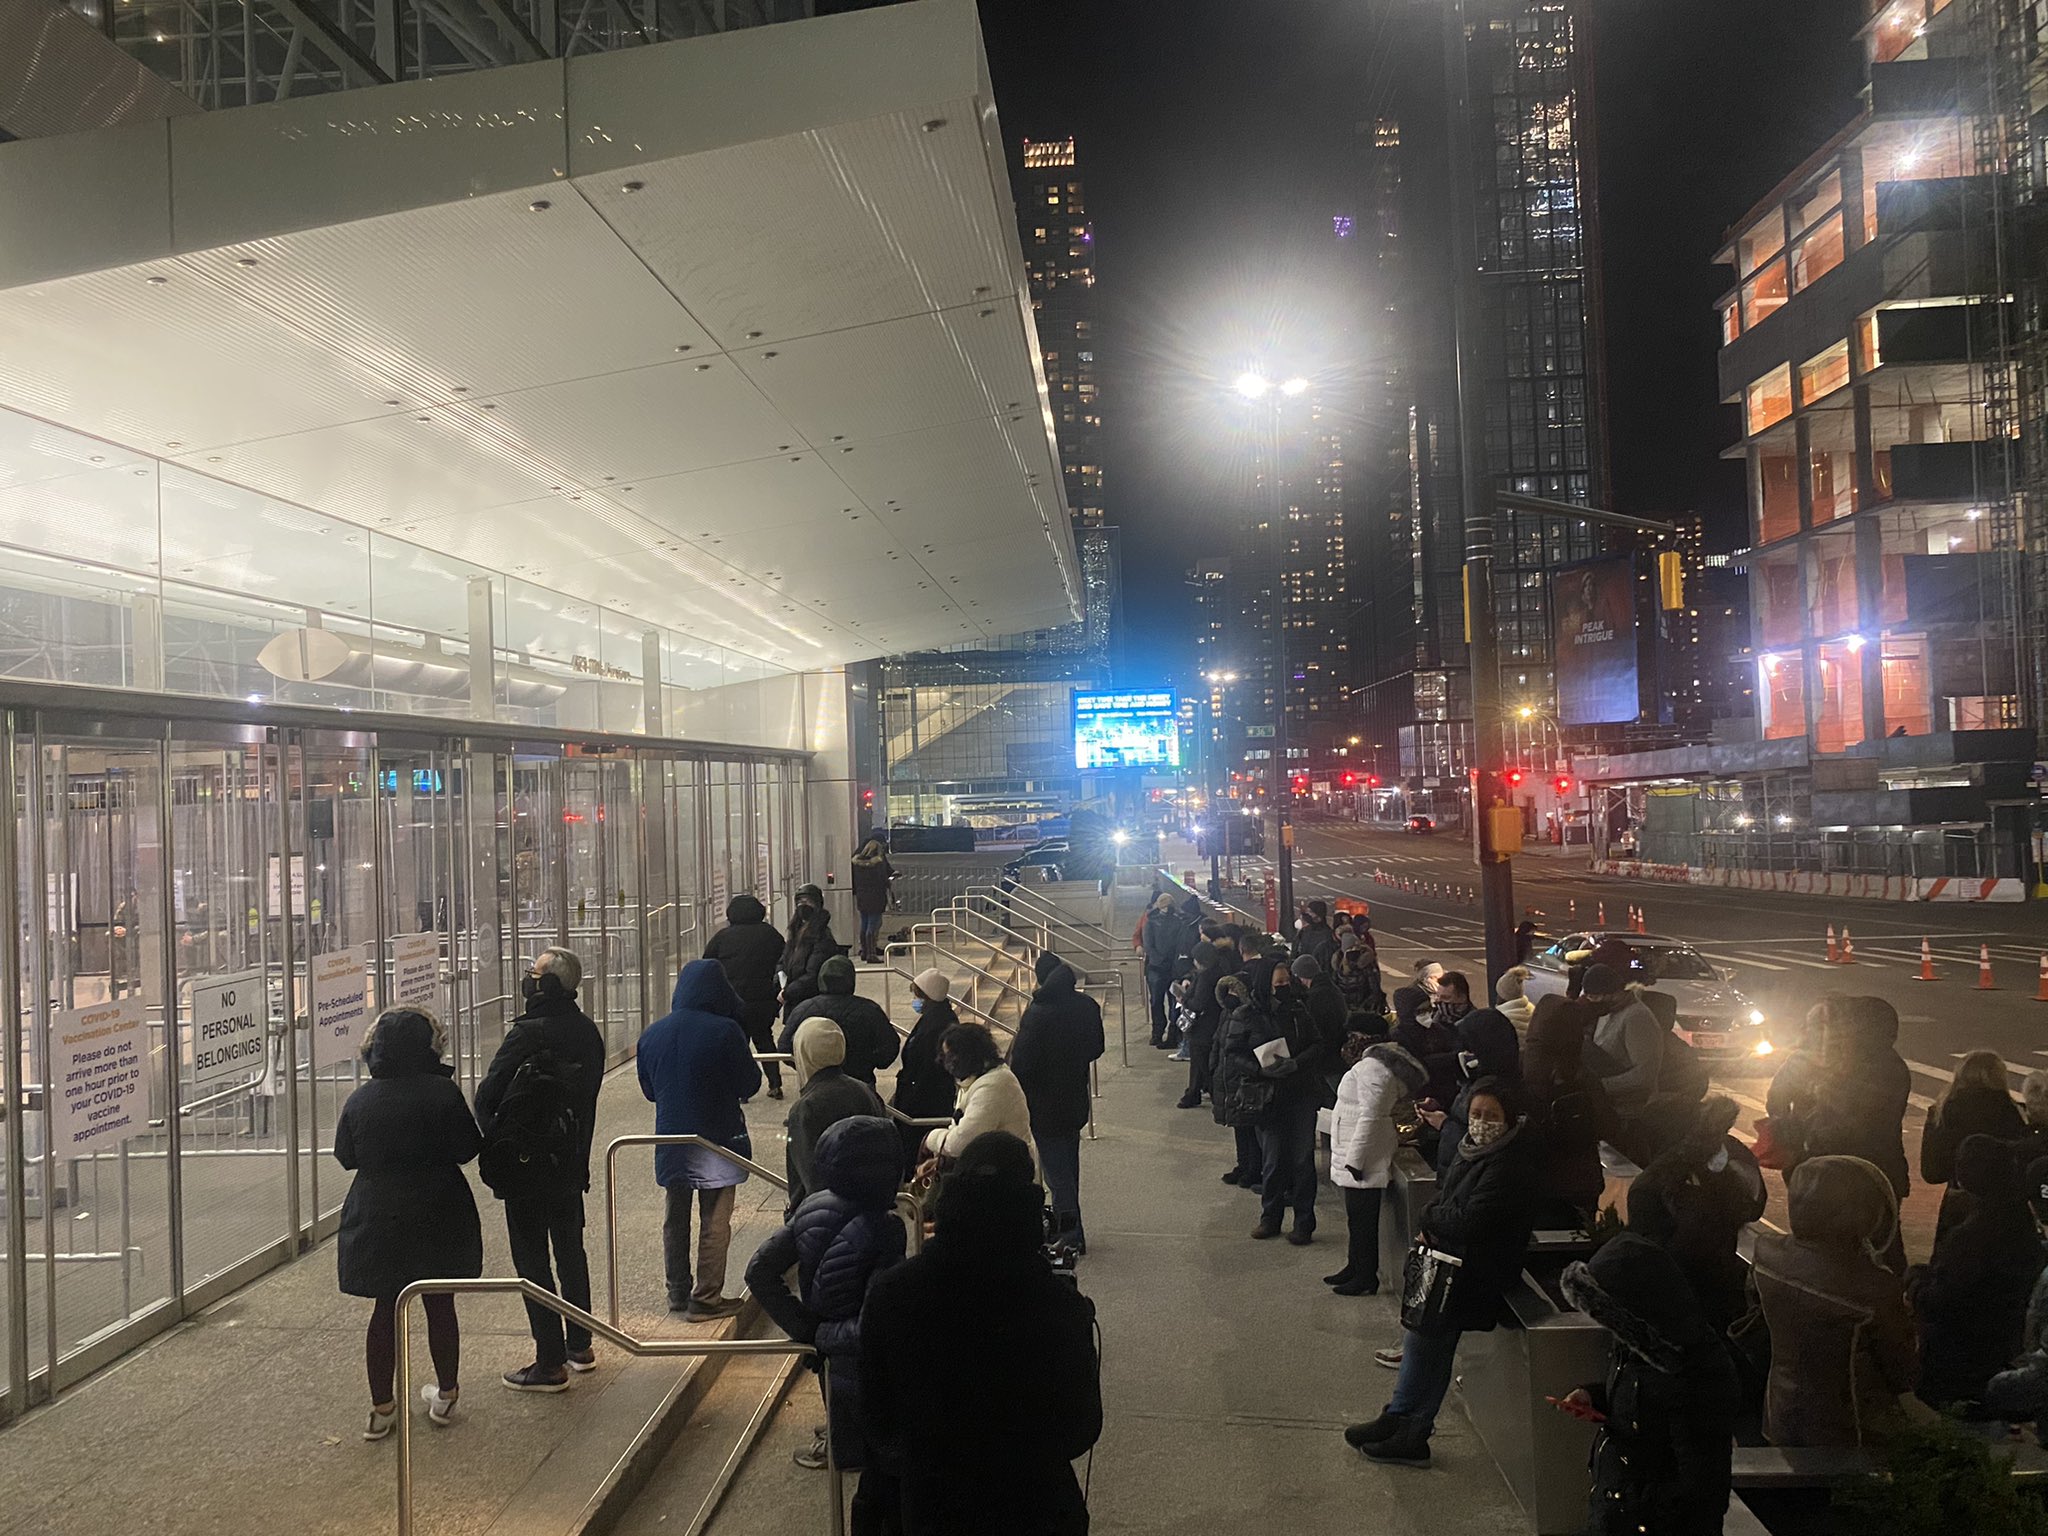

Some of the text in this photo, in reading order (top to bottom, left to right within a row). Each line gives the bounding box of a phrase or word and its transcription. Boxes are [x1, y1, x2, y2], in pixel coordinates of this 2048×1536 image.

[1575, 630, 1613, 644] INTRIGUE
[1582, 621, 1604, 632] PEAK
[222, 991, 236, 1008] NO
[318, 990, 363, 1012] Pre-Scheduled
[81, 1009, 120, 1026] COVID-19
[202, 1013, 256, 1040] PERSONAL
[319, 1007, 363, 1027] Appointments
[63, 1020, 140, 1045] Vaccination Center
[335, 1024, 350, 1036] Only
[72, 1040, 132, 1065] Please do not
[197, 1037, 261, 1070] BELONGINGS
[66, 1054, 138, 1082] arrive more than
[65, 1069, 140, 1098] one hour prior to
[70, 1083, 135, 1114] your COVID-19
[88, 1104, 120, 1121] vaccine
[73, 1115, 132, 1142] appointment.
